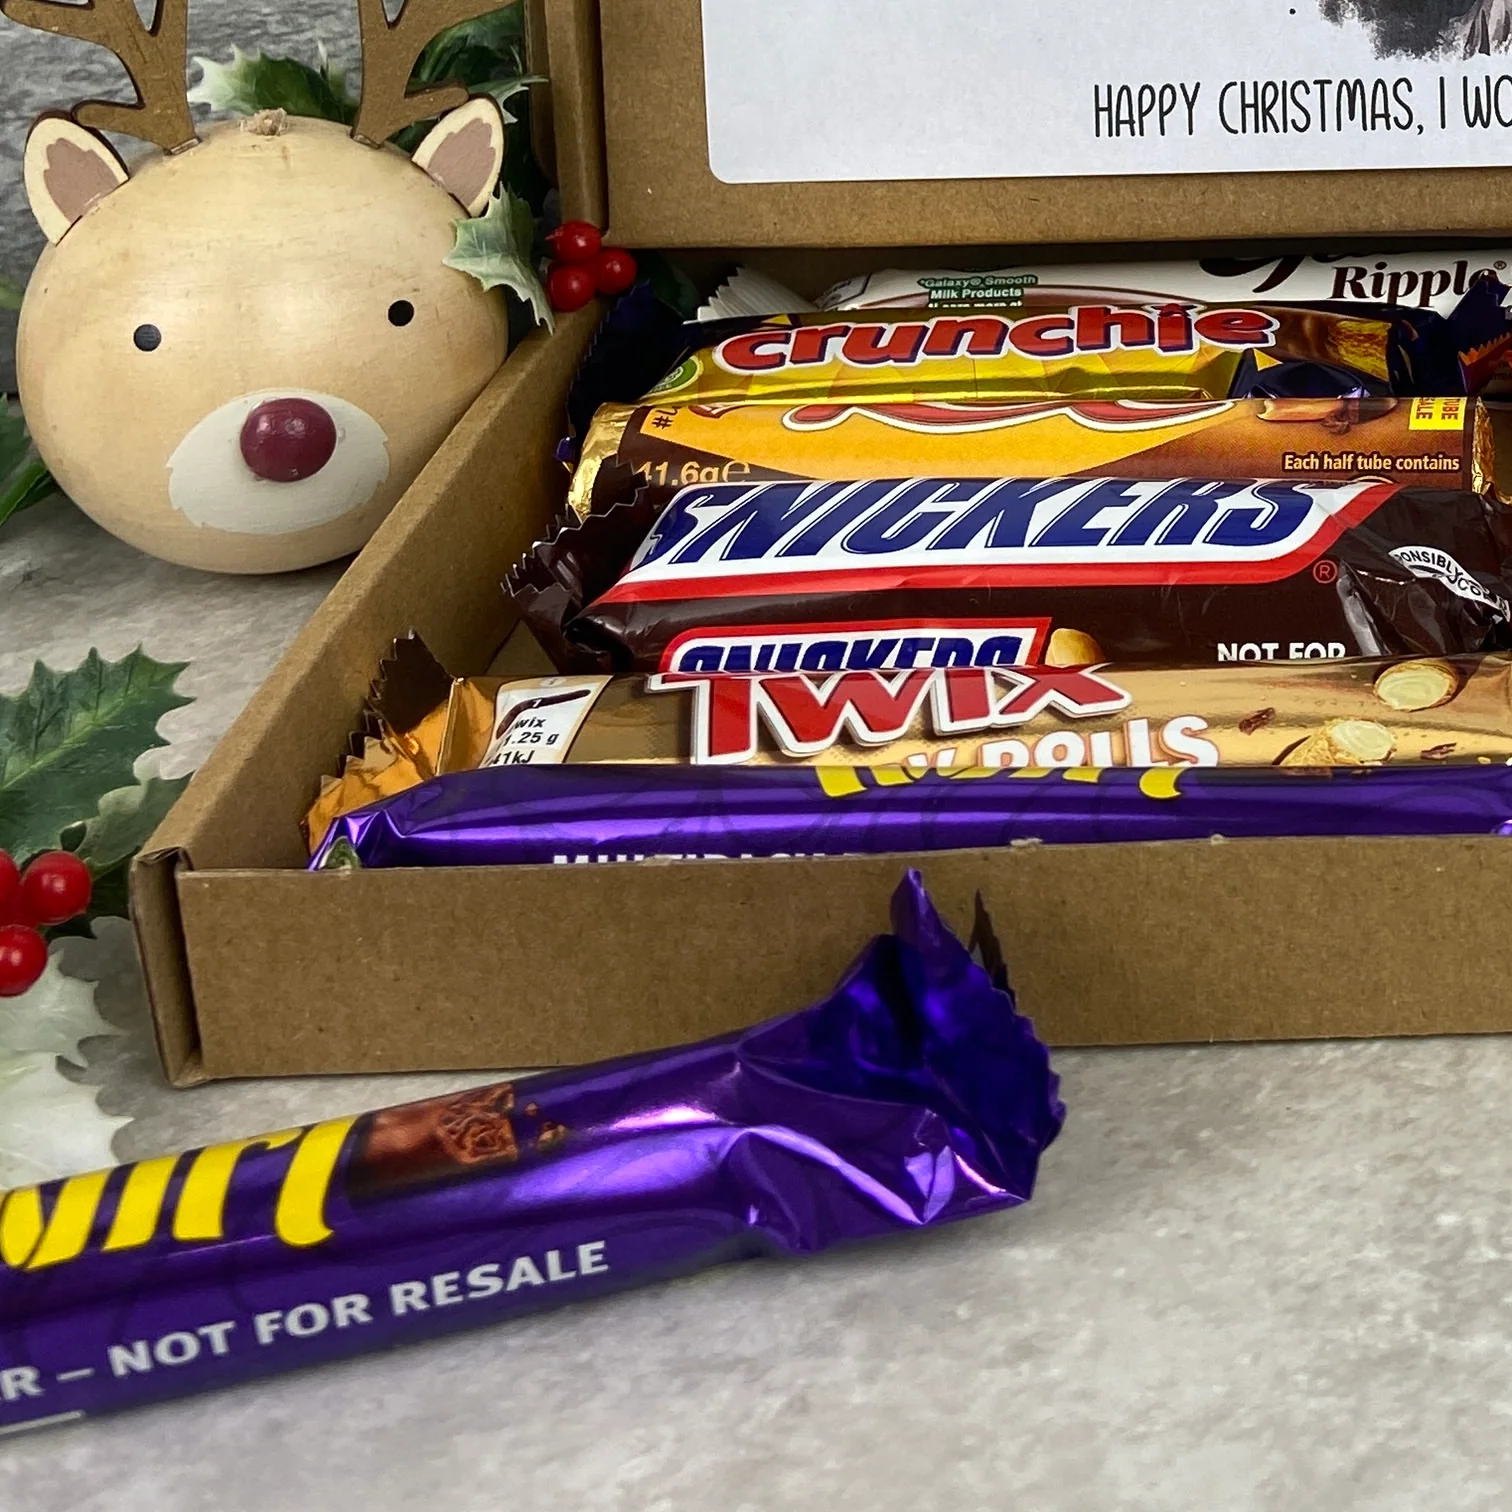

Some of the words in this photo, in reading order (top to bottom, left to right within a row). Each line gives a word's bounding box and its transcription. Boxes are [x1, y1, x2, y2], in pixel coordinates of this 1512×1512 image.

[1095, 82, 1200, 137] HAPPY
[1219, 78, 1423, 135] CHRISTMAS,
[1440, 77, 1445, 129] I
[930, 289, 958, 300] Milk
[962, 287, 1022, 299] Products
[985, 275, 1037, 286] Smooth
[717, 303, 1278, 371] crunchie
[1284, 453, 1320, 470] Each
[1323, 452, 1355, 470] half
[1356, 453, 1392, 470] tube
[1396, 454, 1460, 471] contains
[640, 478, 1322, 566] SNICKERS
[1395, 549, 1465, 580] ONSIBLY
[513, 717, 547, 729] wix
[652, 664, 1128, 761] TWIX
[107, 1320, 236, 1379] NOT
[255, 1291, 374, 1347] FOR
[389, 1239, 611, 1319] RESALE
